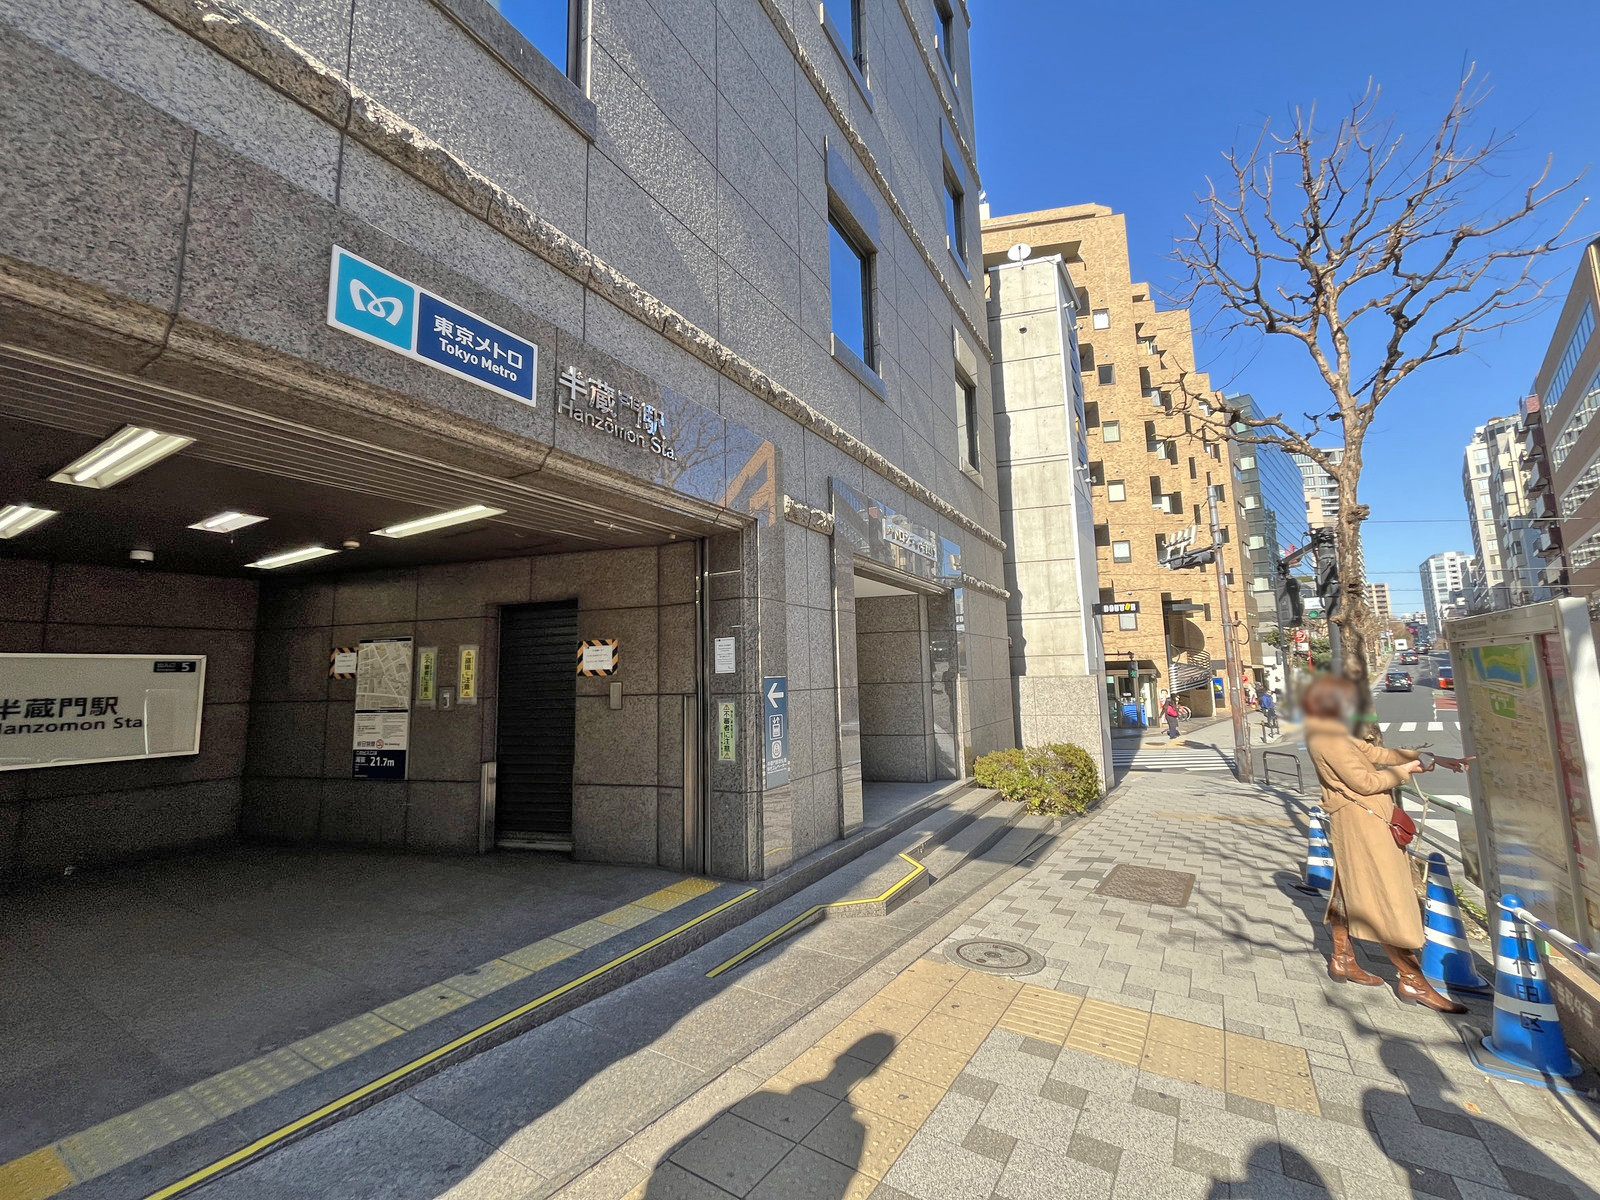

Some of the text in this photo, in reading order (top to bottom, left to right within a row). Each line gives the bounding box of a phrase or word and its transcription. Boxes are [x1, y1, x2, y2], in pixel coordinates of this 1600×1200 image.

[433, 315, 523, 370] 東京メトロ
[439, 337, 518, 382] Tokyo Metro
[559, 366, 666, 437] 半蔵門駅
[650, 436, 677, 461] Sta.
[1103, 602, 1136, 613] DOUTOR
[181, 662, 190, 672] 5
[0, 696, 119, 720] 半蔵門駅
[0, 720, 105, 735] anzomon
[370, 756, 395, 767] 21.7m
[1508, 928, 1545, 1034] 千代田区
